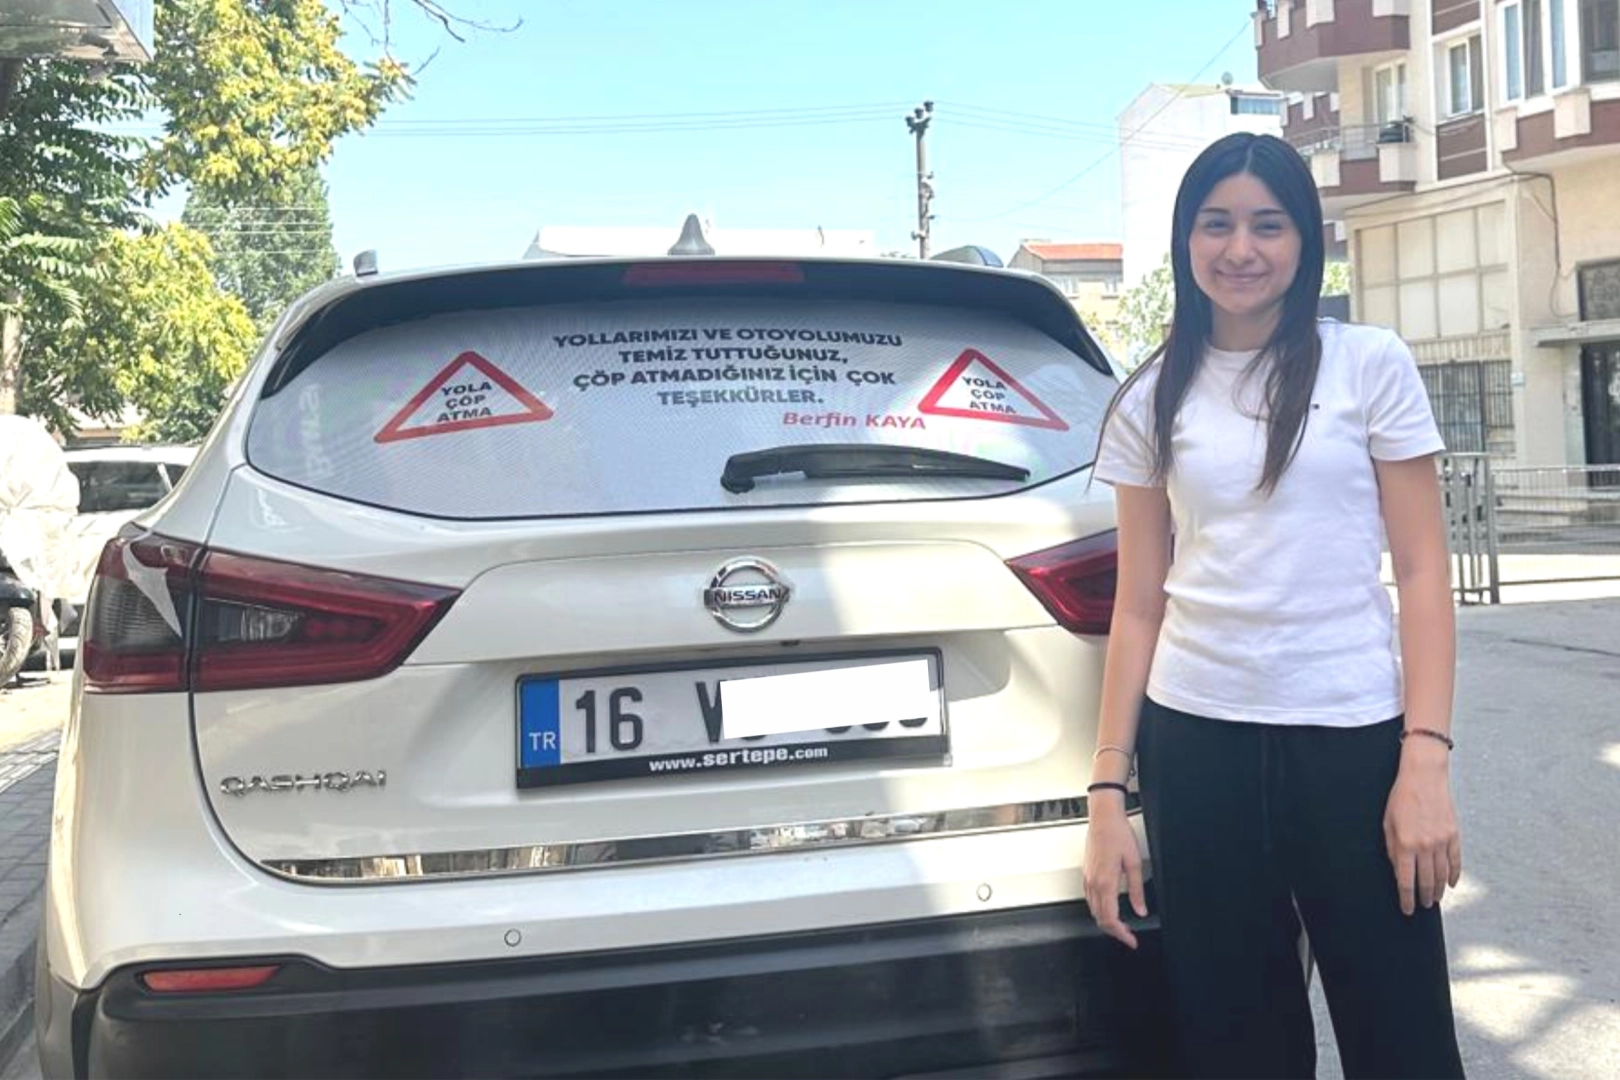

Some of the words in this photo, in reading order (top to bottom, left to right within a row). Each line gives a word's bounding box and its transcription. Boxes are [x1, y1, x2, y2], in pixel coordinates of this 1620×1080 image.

[552, 328, 697, 348] YOLLARIMIZI
[702, 328, 732, 341] VE
[736, 328, 903, 347] OTOYOLUMUZU
[618, 345, 688, 363] TEMİZ
[691, 344, 849, 364] TUTTUĞUNUZ,
[441, 381, 492, 396] YOLA
[572, 370, 625, 392] ÇÖP
[630, 365, 786, 385] ATMADIĞINIZ
[789, 365, 838, 385] İÇİN
[846, 370, 896, 387] ÇOK
[962, 376, 1007, 390] YOLA
[657, 386, 825, 408] TEŞEKKÜRLER.
[436, 407, 492, 422] ATMA
[969, 401, 1017, 414] ATMA
[782, 412, 857, 429] Berfin
[865, 414, 926, 430] KAYA
[714, 588, 781, 603] NISSAN
[576, 686, 643, 753] 16
[529, 731, 556, 751] TR
[649, 747, 828, 772] www.sertepe.com
[219, 770, 388, 797] QASHQAI
